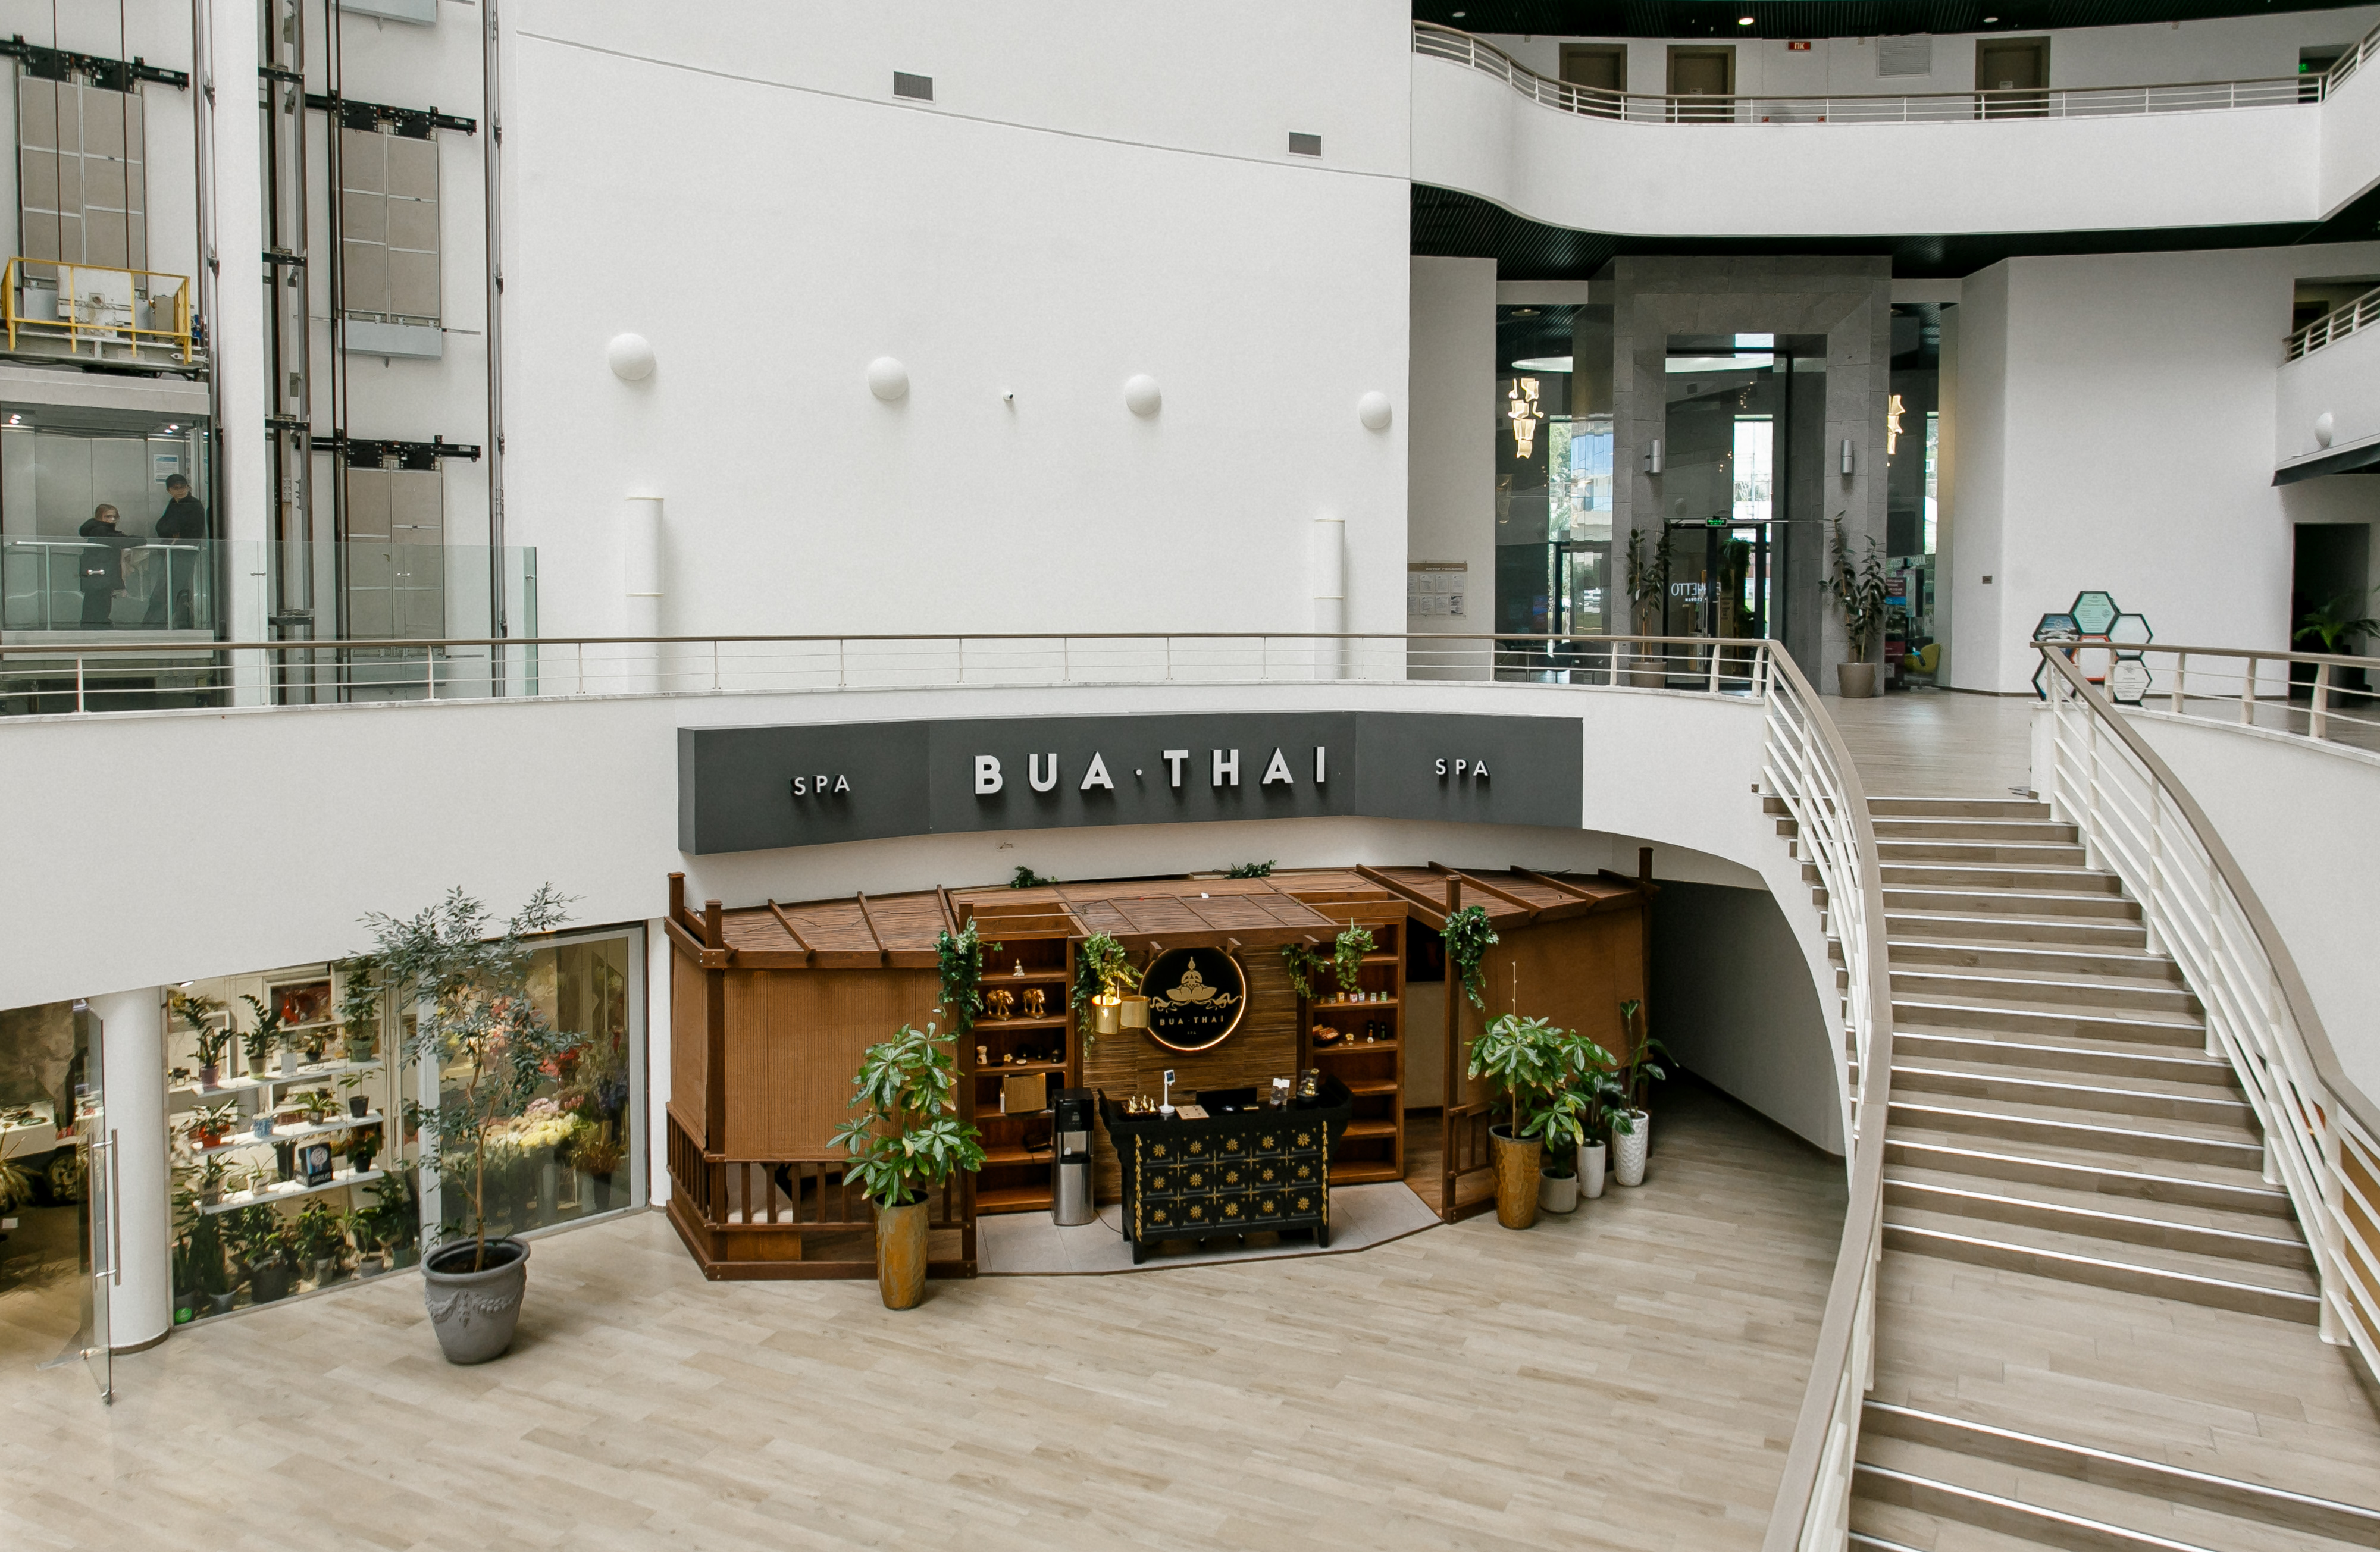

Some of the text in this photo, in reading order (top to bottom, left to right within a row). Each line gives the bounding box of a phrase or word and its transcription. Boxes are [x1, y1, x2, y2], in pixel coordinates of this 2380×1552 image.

[973, 746, 1325, 795] BUA THAI
[1435, 758, 1489, 776] SPA
[793, 774, 850, 795] SPA
[1160, 1015, 1224, 1026] BUA THAI
